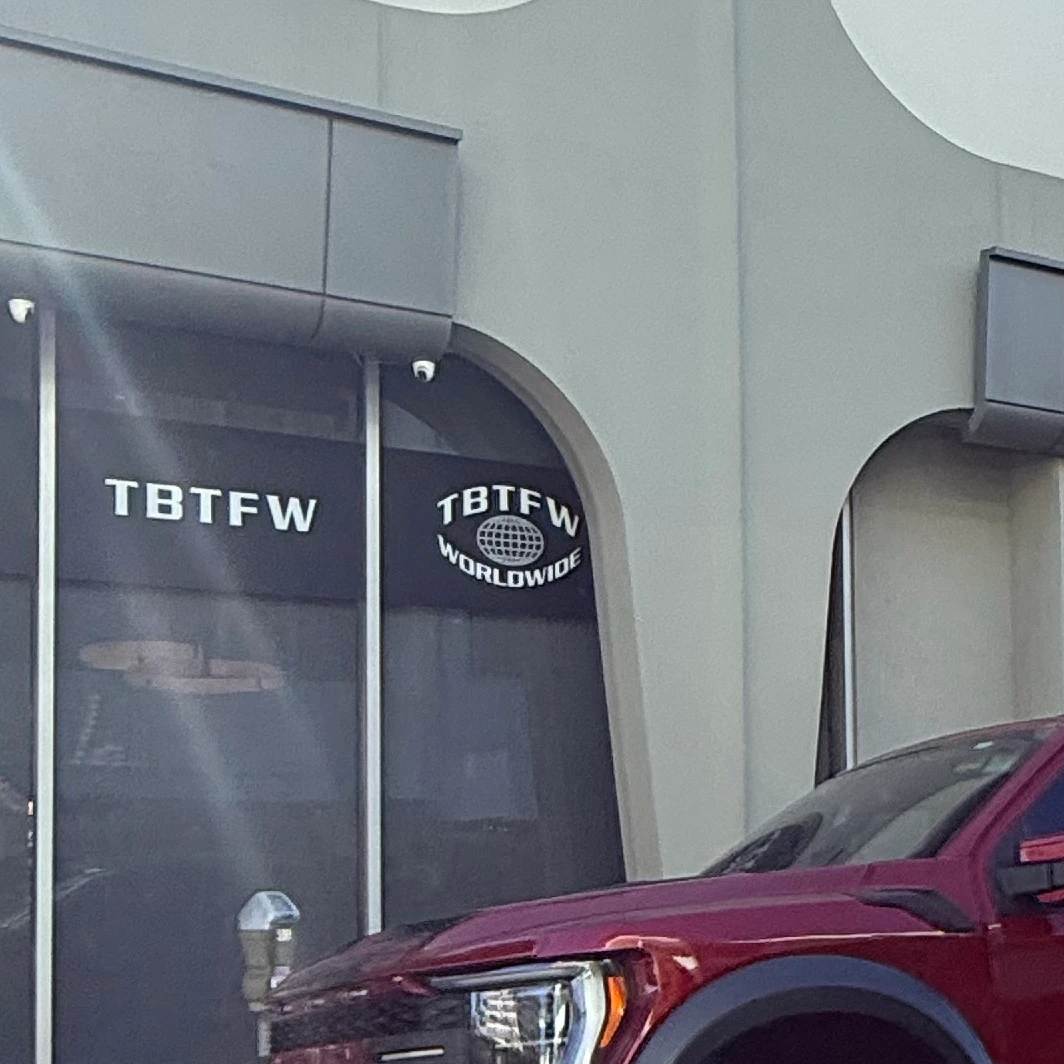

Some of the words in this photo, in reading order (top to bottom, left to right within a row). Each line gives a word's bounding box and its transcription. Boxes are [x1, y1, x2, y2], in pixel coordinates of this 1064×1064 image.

[104, 478, 318, 532] TBTFW
[436, 484, 580, 538] TBTFW
[436, 533, 582, 588] WORLDWIDE
